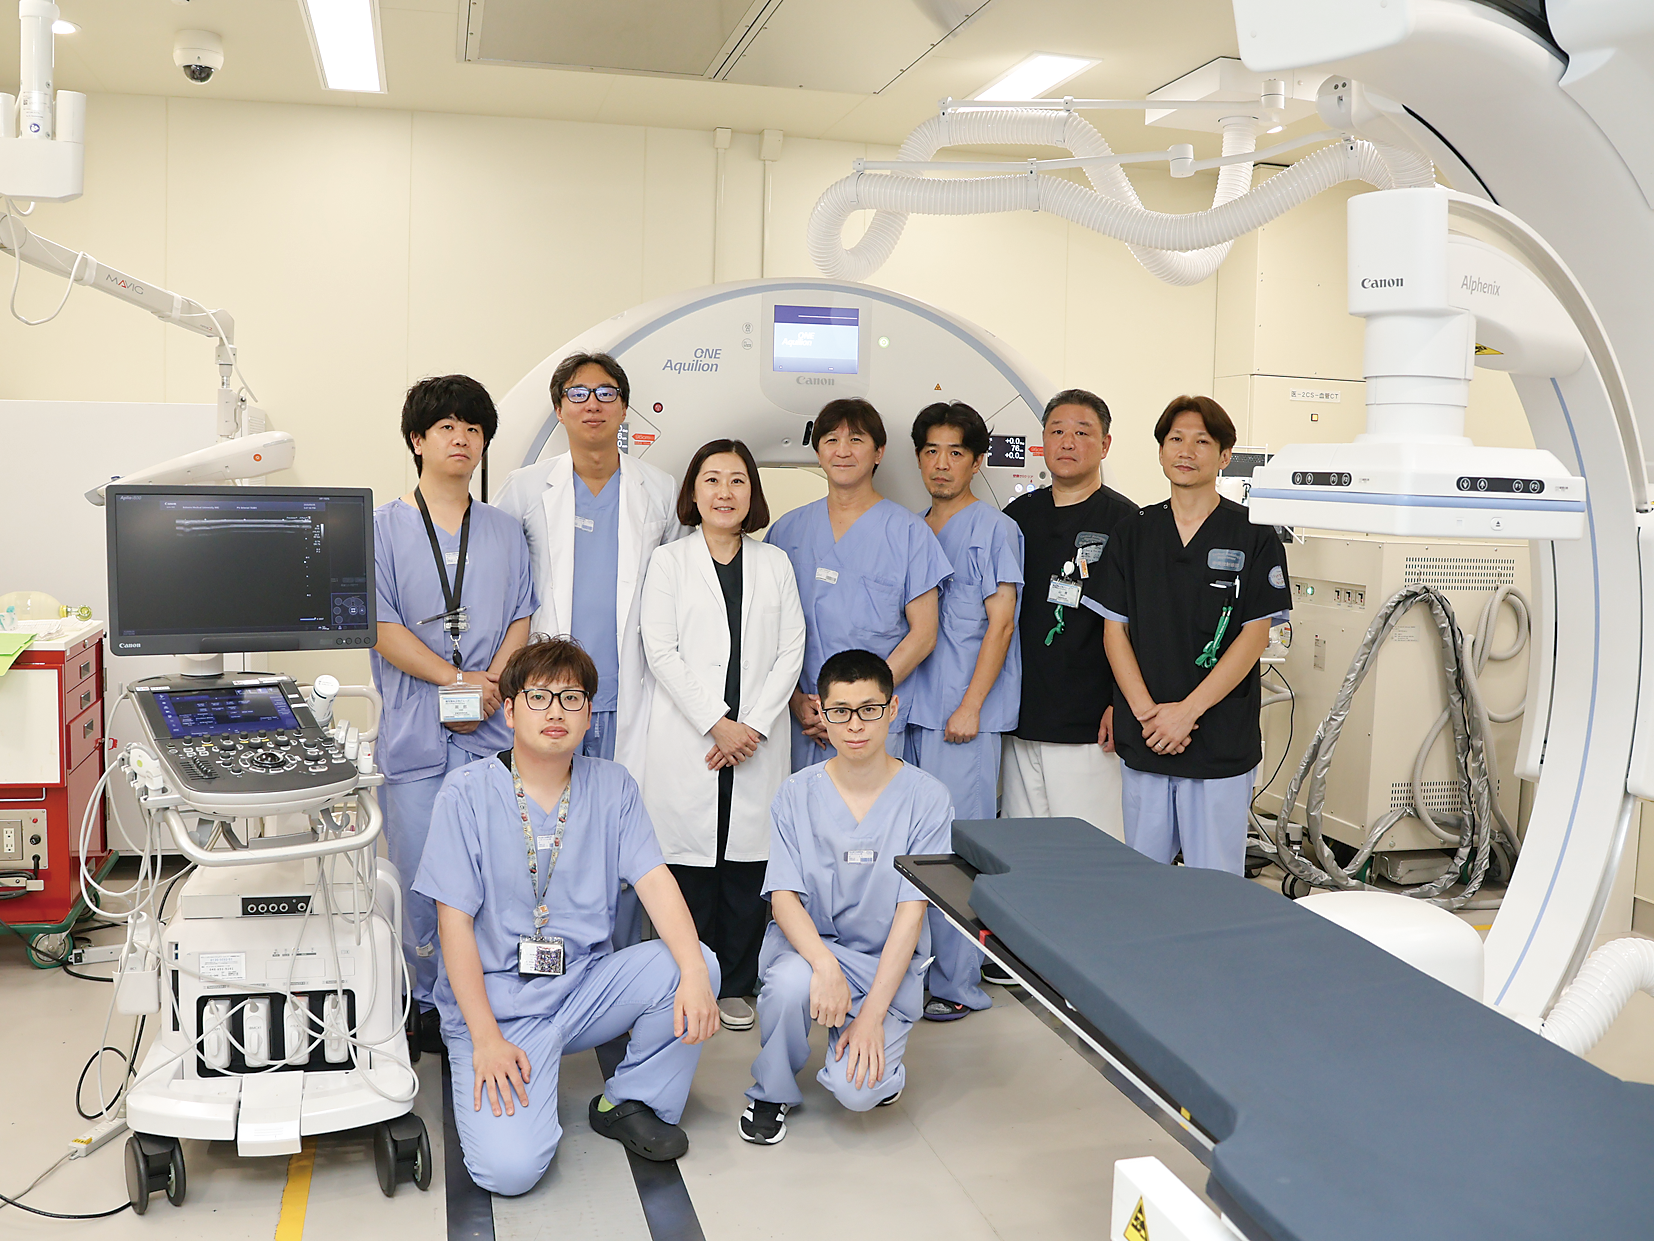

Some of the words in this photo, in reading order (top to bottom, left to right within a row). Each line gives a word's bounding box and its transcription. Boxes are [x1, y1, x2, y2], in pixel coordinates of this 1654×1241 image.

[105, 274, 144, 295] MAVIG
[1361, 277, 1404, 289] Canon
[1460, 275, 1501, 297] Alphenix
[694, 347, 722, 359] ONE
[662, 359, 719, 375] Aquilion
[796, 375, 835, 386] Canon
